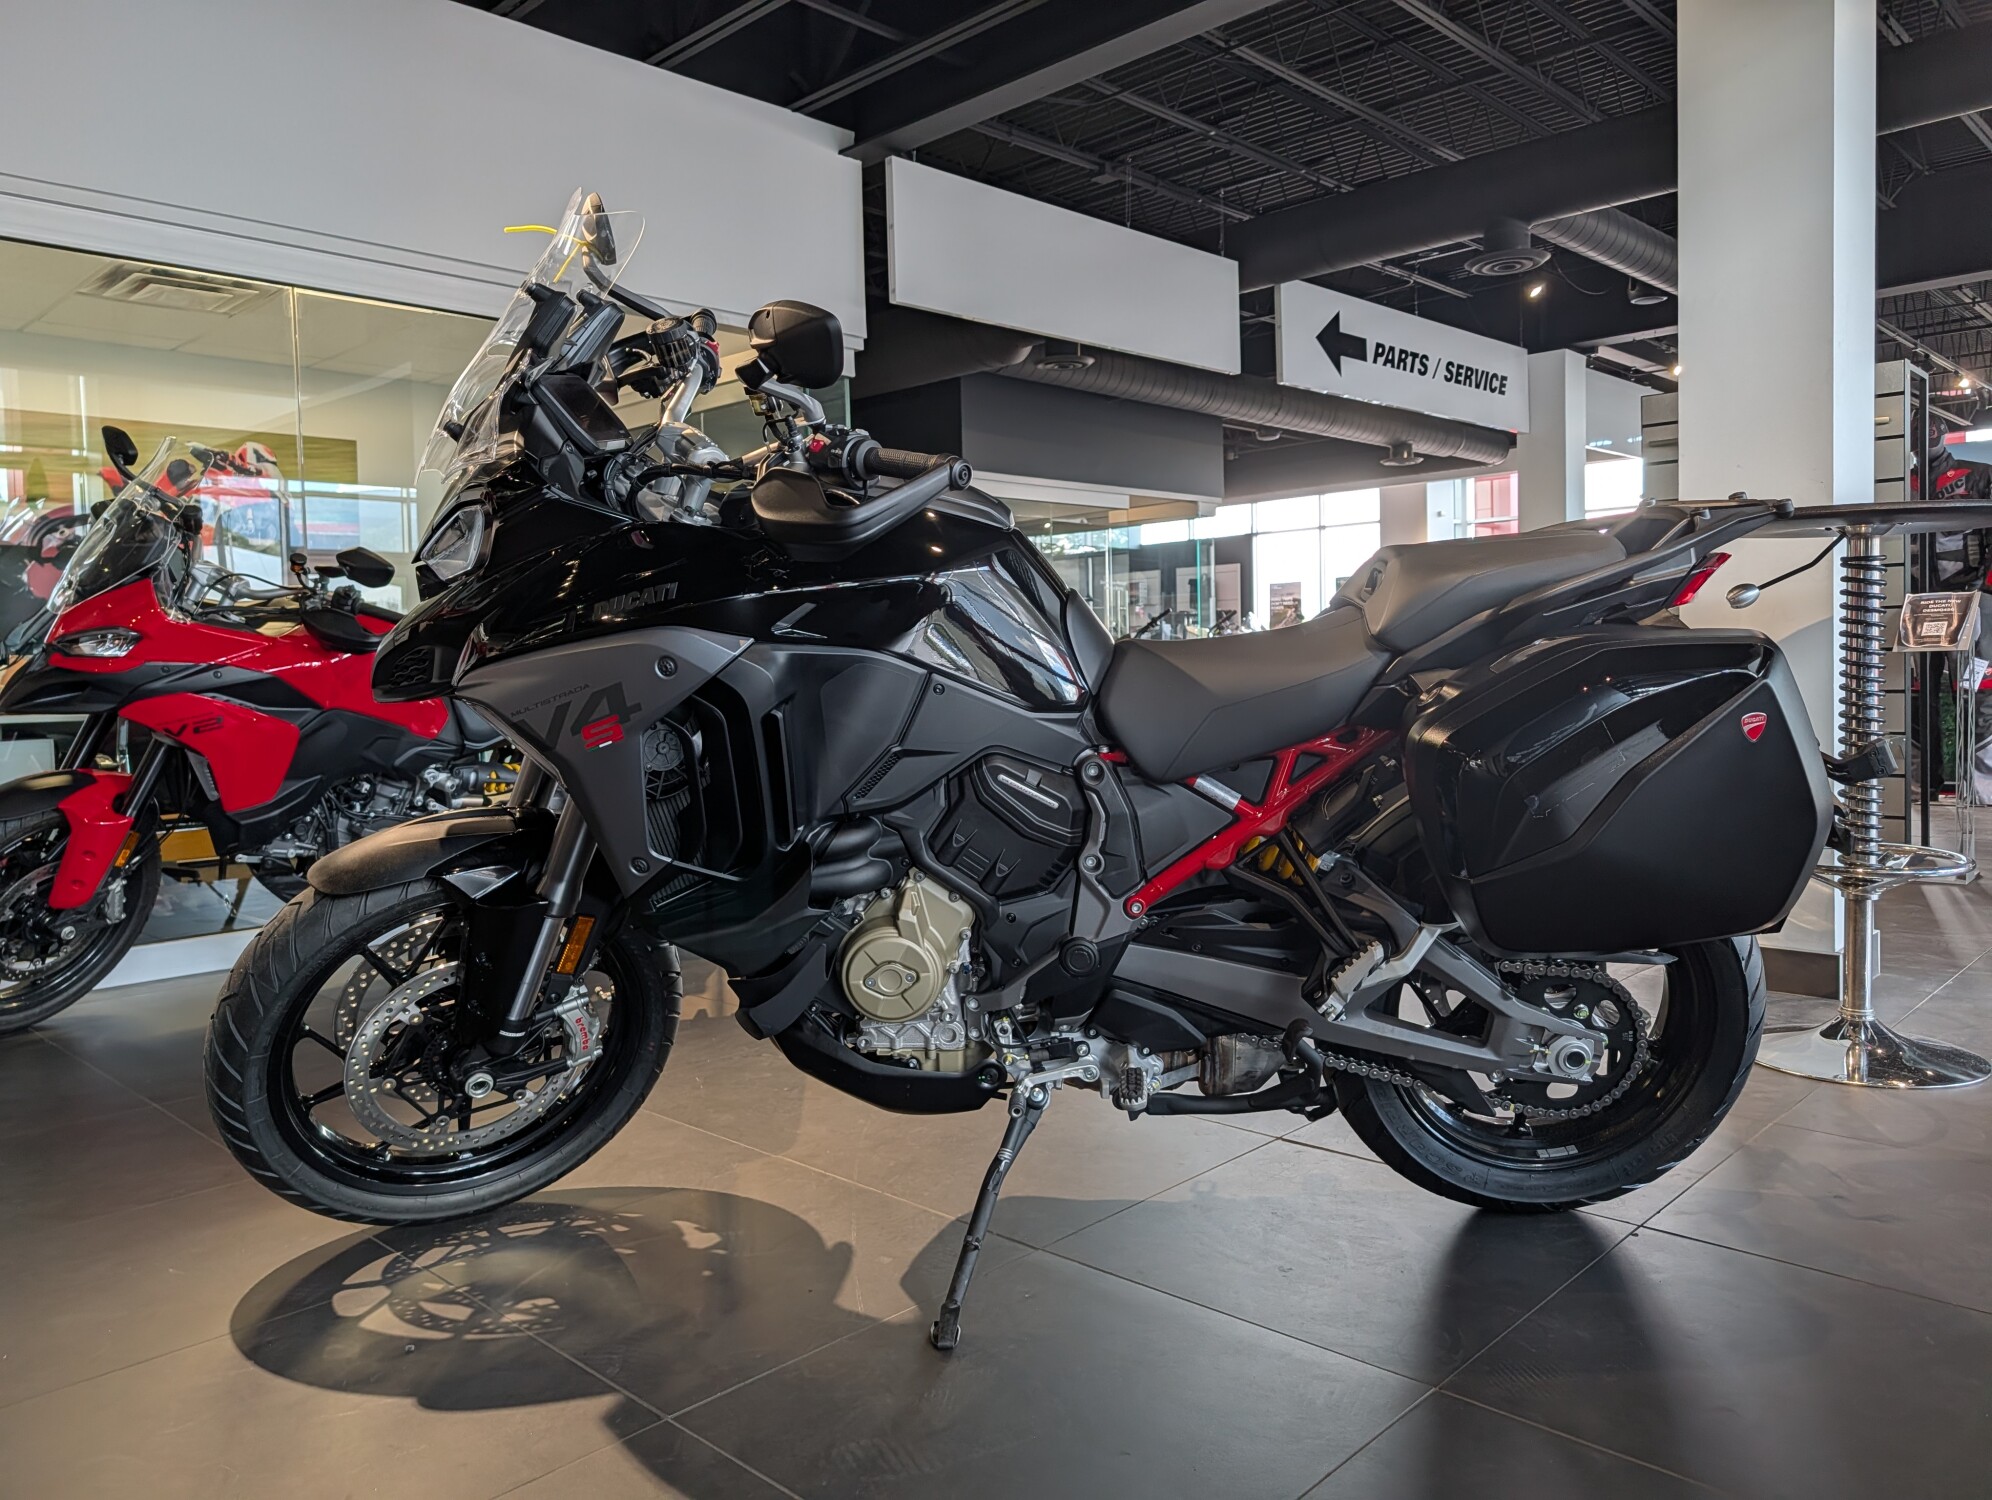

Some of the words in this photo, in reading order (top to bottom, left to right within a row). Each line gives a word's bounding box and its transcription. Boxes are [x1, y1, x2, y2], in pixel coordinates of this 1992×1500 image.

[1372, 341, 1430, 377] PARTS
[1431, 357, 1442, 380] /
[1443, 360, 1509, 396] SERVICE
[592, 581, 679, 620] DUCATI
[510, 683, 590, 718] MULTISTRADA
[513, 681, 642, 752] V4
[582, 714, 625, 750] S
[1744, 716, 1765, 724] DUCATI
[575, 1016, 590, 1051] brembo
